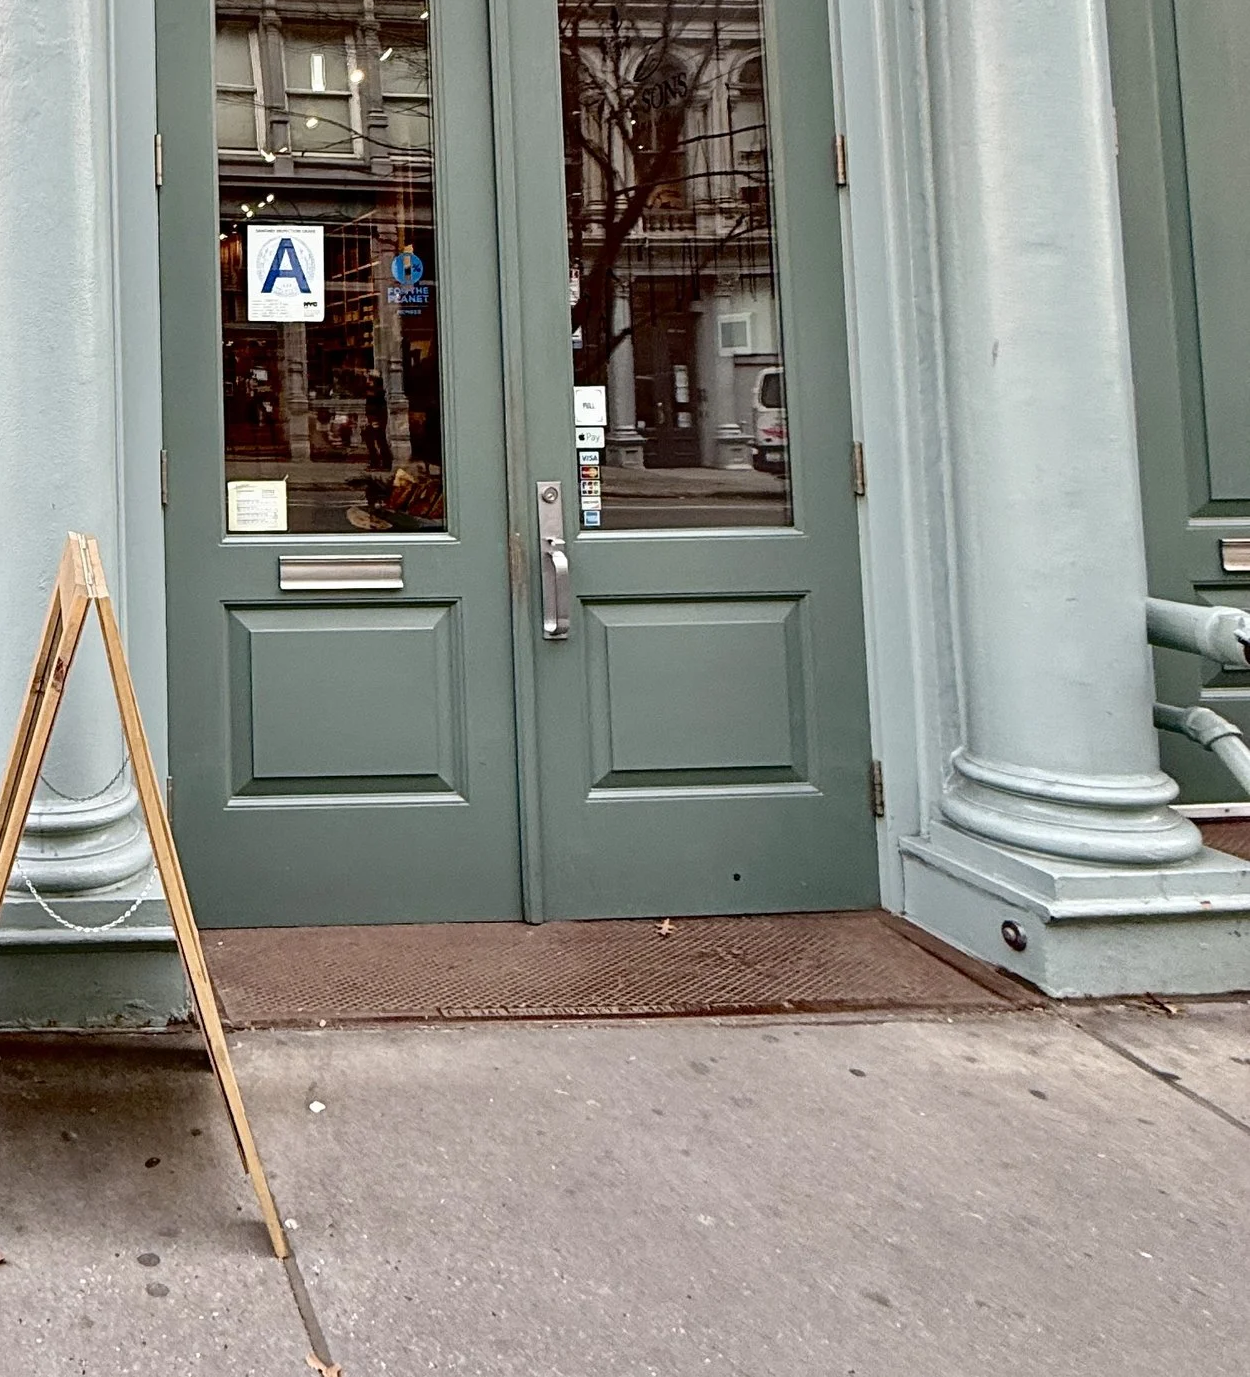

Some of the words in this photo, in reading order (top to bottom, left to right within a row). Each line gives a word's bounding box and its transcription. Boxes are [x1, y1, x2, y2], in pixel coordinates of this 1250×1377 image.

[641, 72, 688, 113] SONS
[261, 237, 312, 294] A
[387, 295, 429, 303] PLANET
[586, 432, 600, 443] Pay
